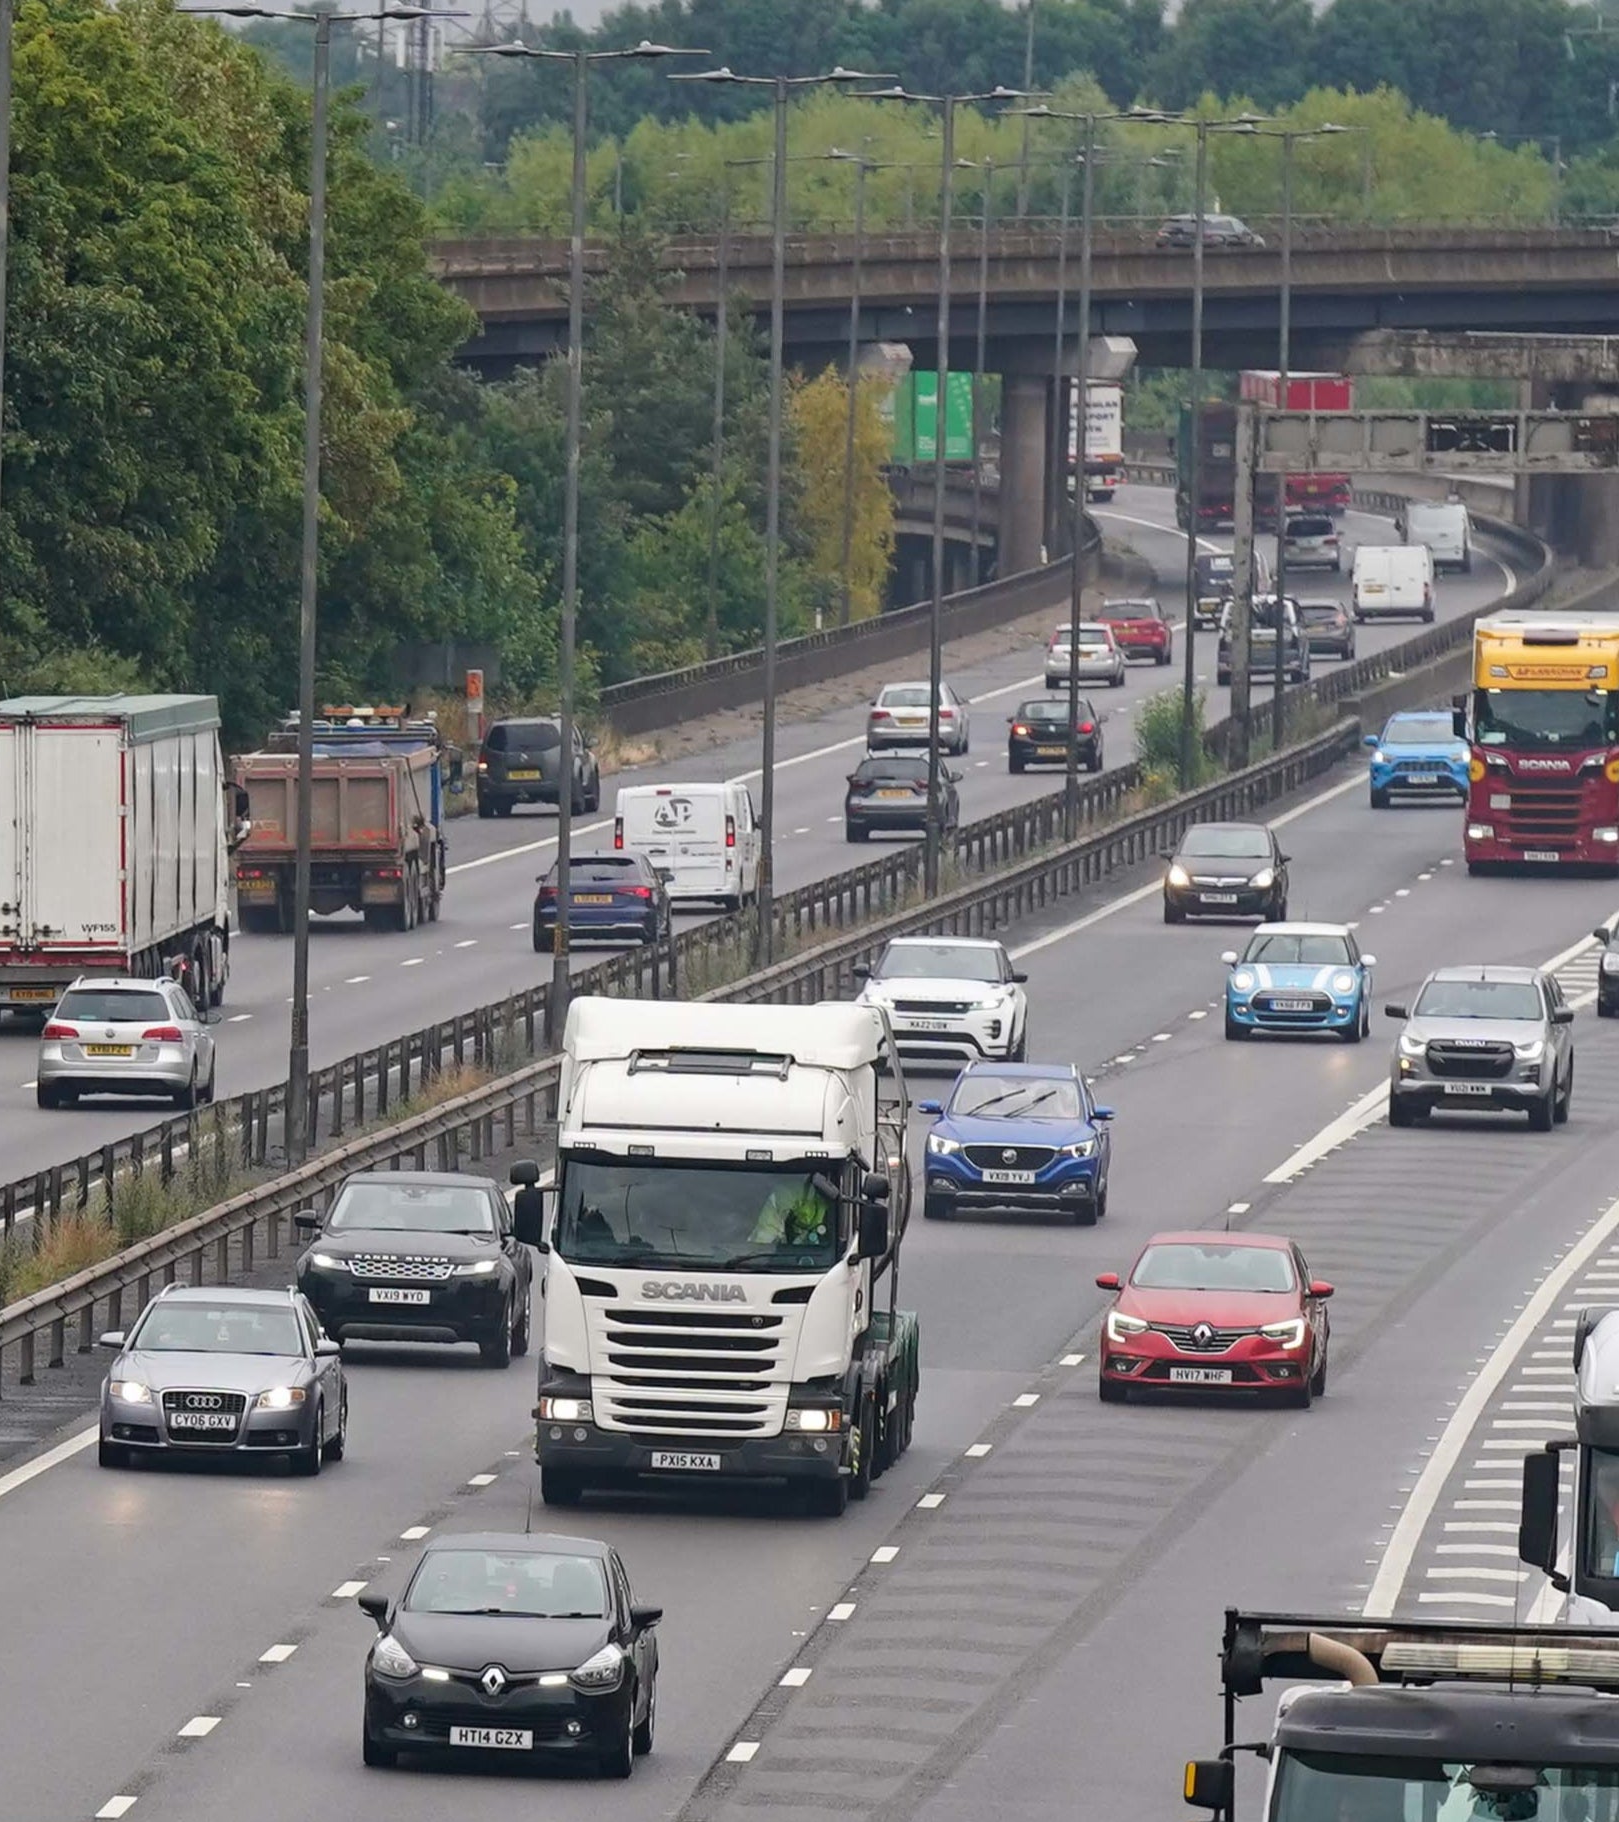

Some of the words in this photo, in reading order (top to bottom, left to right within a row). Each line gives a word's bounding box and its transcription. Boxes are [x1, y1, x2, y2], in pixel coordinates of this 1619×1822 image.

[1518, 759, 1571, 770] SCANIA
[81, 923, 117, 933] WF155
[376, 1290, 399, 1300] VX19
[641, 1281, 748, 1304] SCANIA
[1176, 1369, 1200, 1379] HV17
[175, 1414, 205, 1427] CY06
[208, 1415, 232, 1427] GXV
[659, 1454, 688, 1467] PX15
[691, 1456, 714, 1468] KXA
[459, 1729, 491, 1742] HT14
[495, 1732, 523, 1745] GZX
